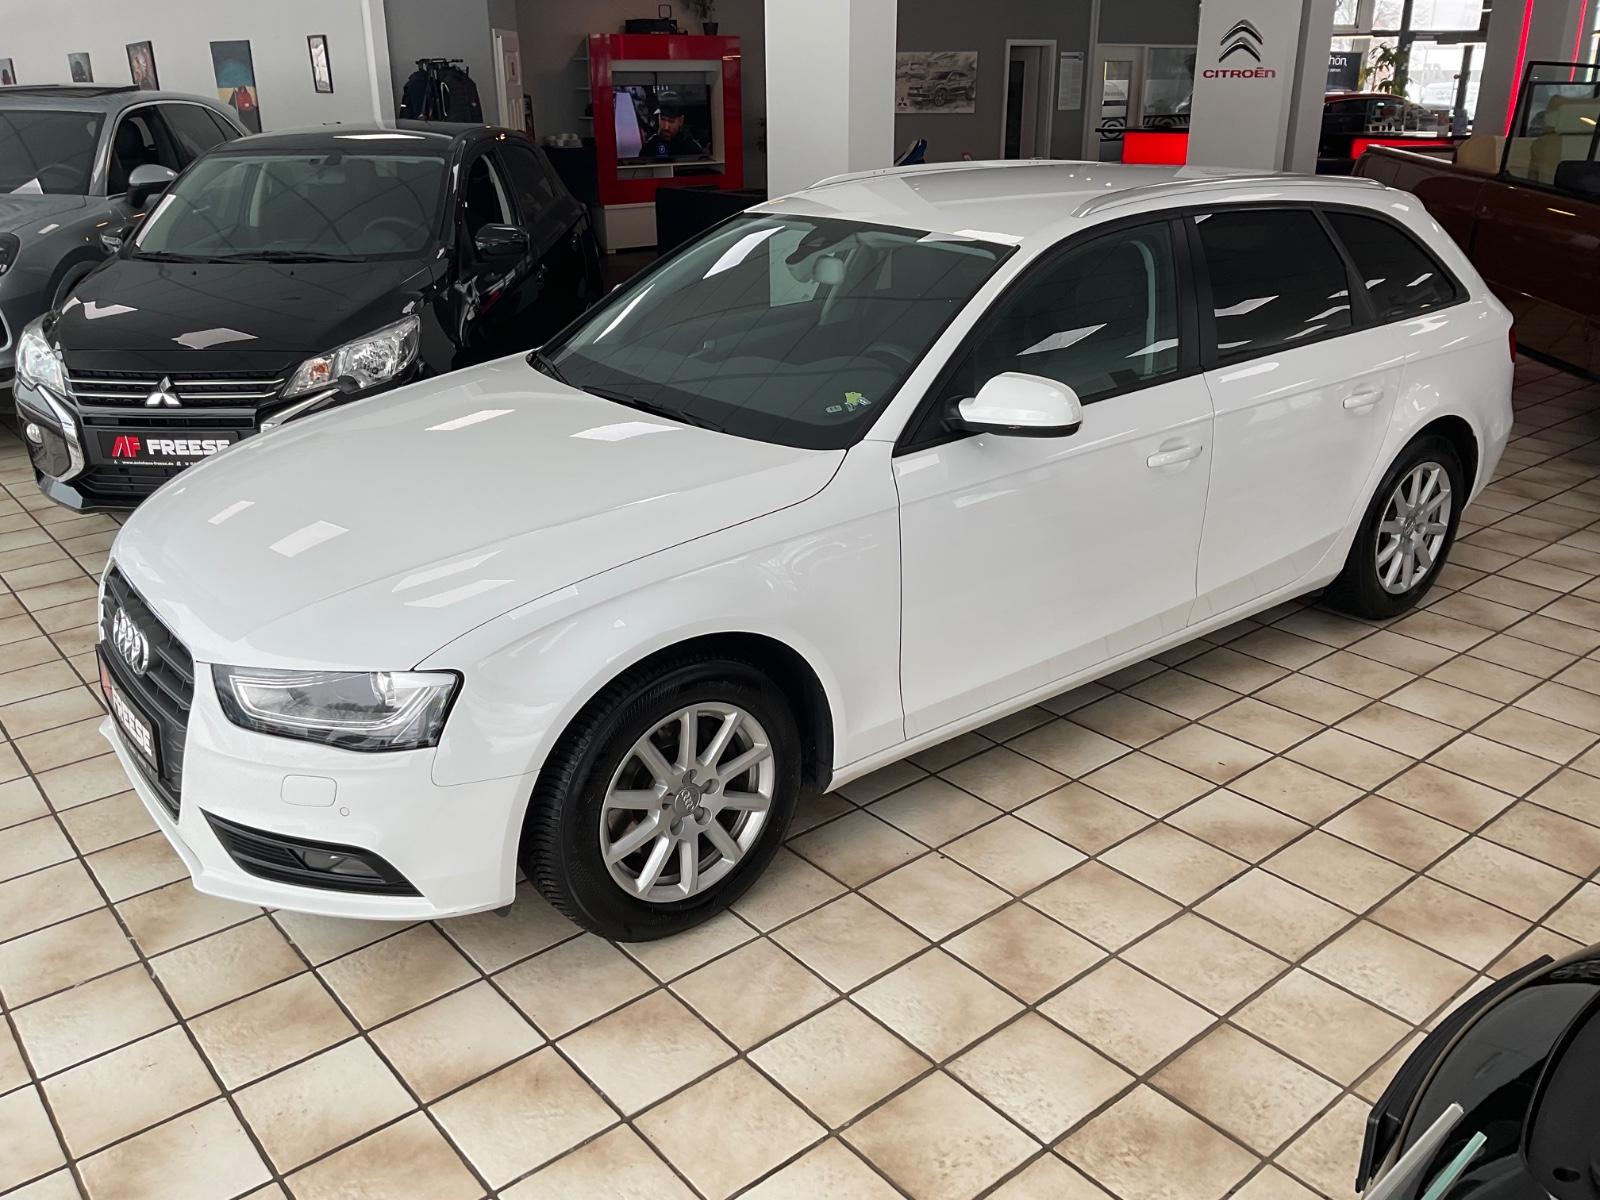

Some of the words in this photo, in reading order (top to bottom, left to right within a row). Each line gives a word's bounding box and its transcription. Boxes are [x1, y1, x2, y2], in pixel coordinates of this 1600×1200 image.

[1203, 67, 1276, 78] CITROËN
[111, 435, 141, 457] AF
[111, 685, 152, 757] FREESE
